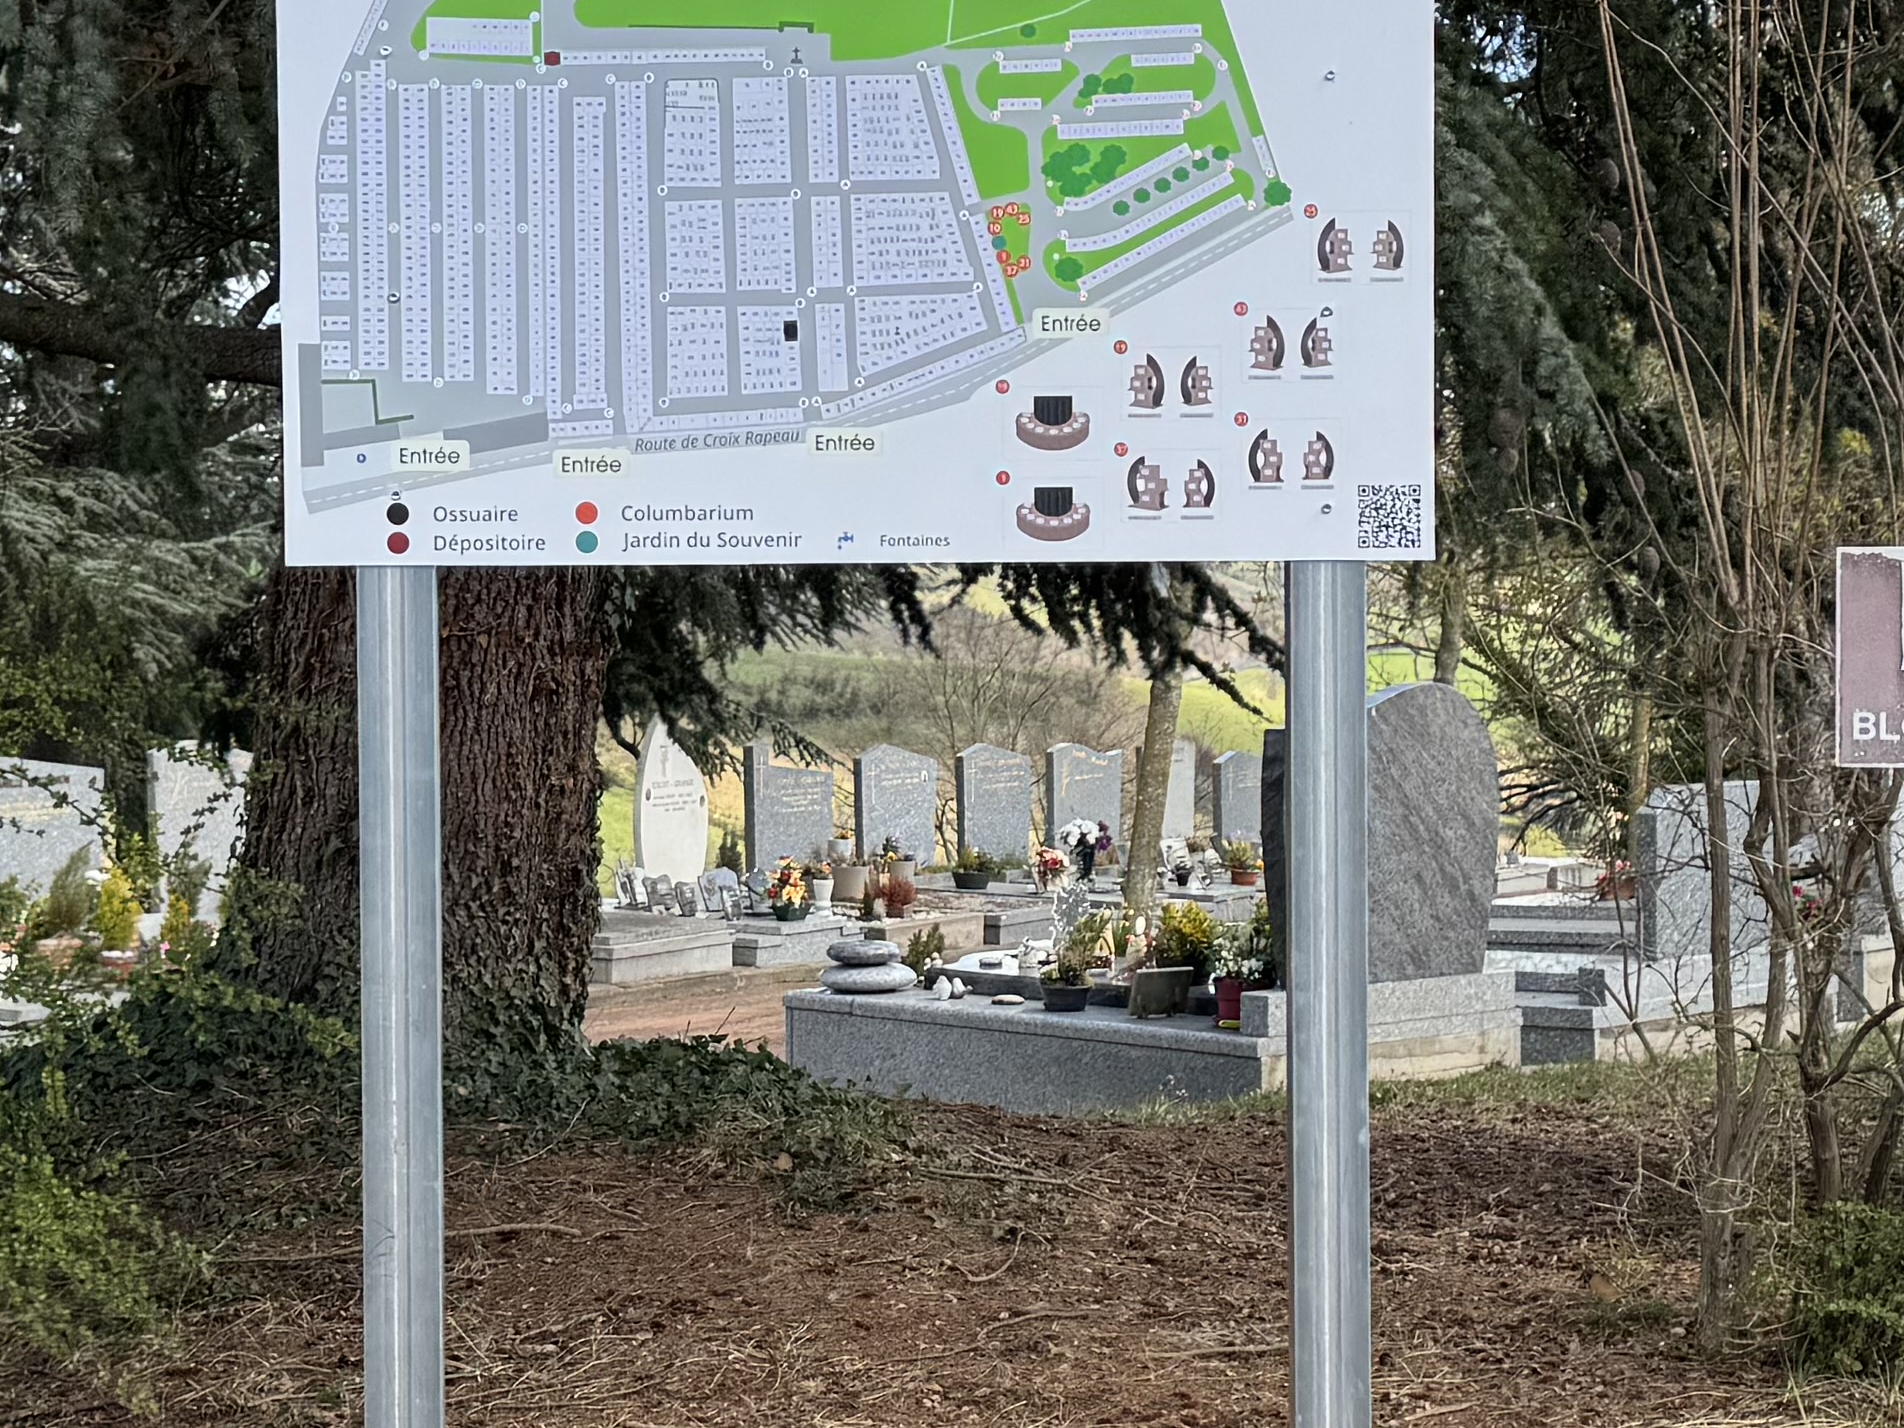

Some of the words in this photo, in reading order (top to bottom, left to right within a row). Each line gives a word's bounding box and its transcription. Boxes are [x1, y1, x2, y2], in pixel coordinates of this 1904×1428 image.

[1041, 314, 1101, 332] Entrée
[634, 437, 677, 453] Route
[680, 434, 699, 450] de
[703, 431, 741, 448] Croix
[744, 430, 800, 447] Rapeau
[815, 433, 875, 451] Entrée
[399, 446, 461, 464] Entrée
[561, 455, 622, 473] Entrée
[433, 506, 518, 523] Ossuaire
[621, 504, 754, 522] Columbarium
[434, 534, 546, 555] Dépositoire
[621, 531, 680, 553] Jardin
[686, 531, 710, 548] du
[717, 531, 802, 548] Souvenir
[880, 534, 951, 547] Fontaines
